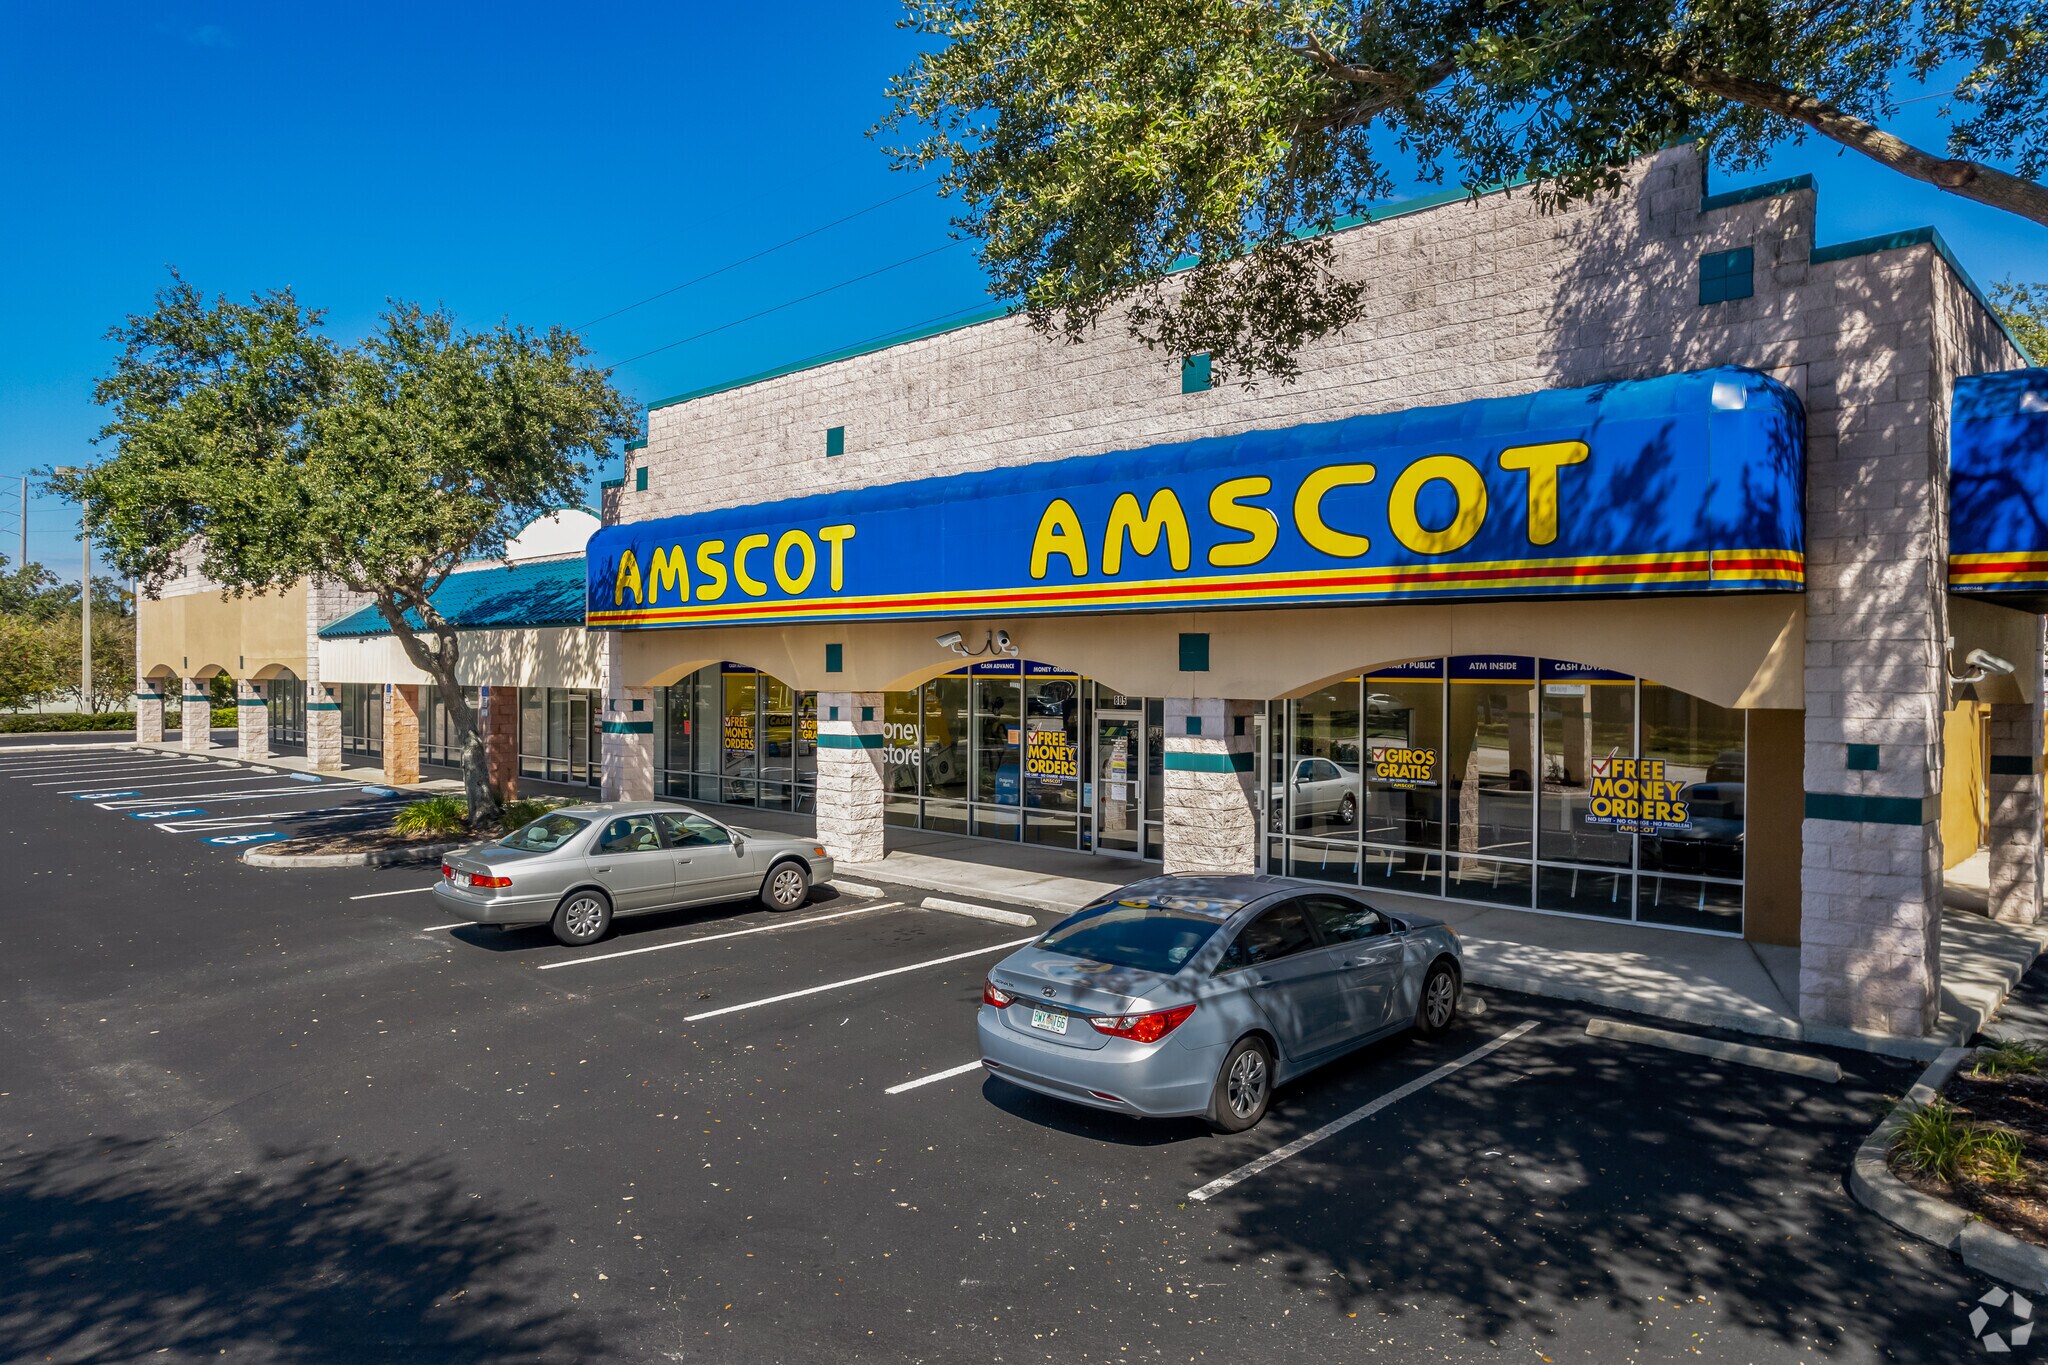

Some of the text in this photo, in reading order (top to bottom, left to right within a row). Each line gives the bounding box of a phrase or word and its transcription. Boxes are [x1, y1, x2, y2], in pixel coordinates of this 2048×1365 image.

[1030, 440, 1591, 579] AMSCOT
[615, 524, 856, 606] AMSCOT
[1409, 661, 1436, 669] PUBLIC
[1469, 662, 1517, 670] ATM INSIDE
[1554, 663, 1578, 671] CASH
[1114, 695, 1127, 705] 805
[730, 716, 748, 727] FREE
[725, 727, 753, 739] MONEY
[1038, 731, 1066, 746] FREE
[725, 738, 754, 750] ORDERS
[1028, 745, 1075, 761] MONEY
[1385, 748, 1436, 765] GIROS
[1028, 758, 1077, 776] ORDERS
[1376, 762, 1431, 780] GRATIS
[1612, 759, 1664, 780] FREE
[1591, 777, 1683, 801] MONEY
[1591, 797, 1687, 823] ORDERS
